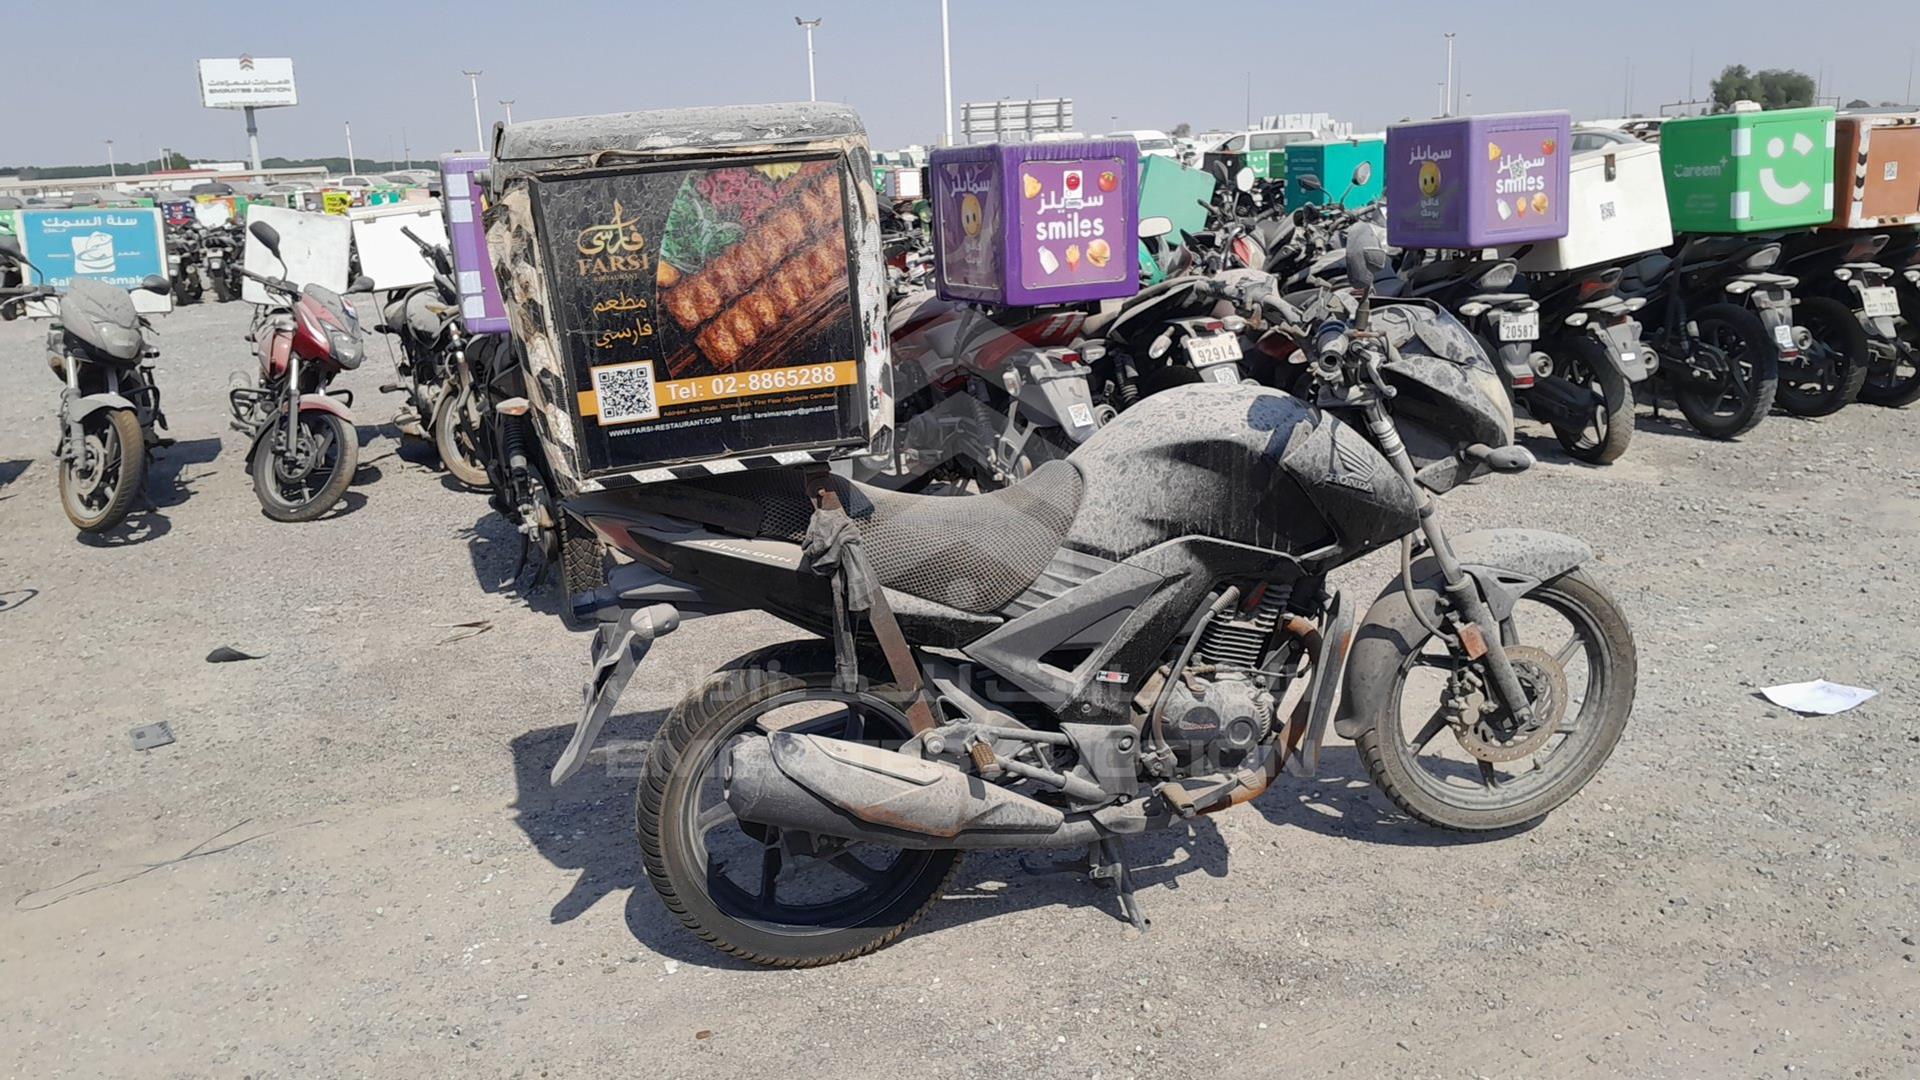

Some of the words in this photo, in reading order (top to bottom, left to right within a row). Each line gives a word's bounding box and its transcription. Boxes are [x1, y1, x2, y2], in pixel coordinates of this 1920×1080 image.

[1036, 212, 1104, 241] smiles
[577, 253, 649, 276] FARSI
[592, 291, 647, 318] مطعم
[1198, 344, 1236, 364] 92914
[666, 382, 704, 401] Tel:
[712, 365, 836, 395] 02-8865288
[608, 416, 723, 438] WWW.FARSI-RESTAURANT.COM
[754, 403, 839, 419] farsimanager@gmail.com
[1323, 472, 1375, 493] HONDA
